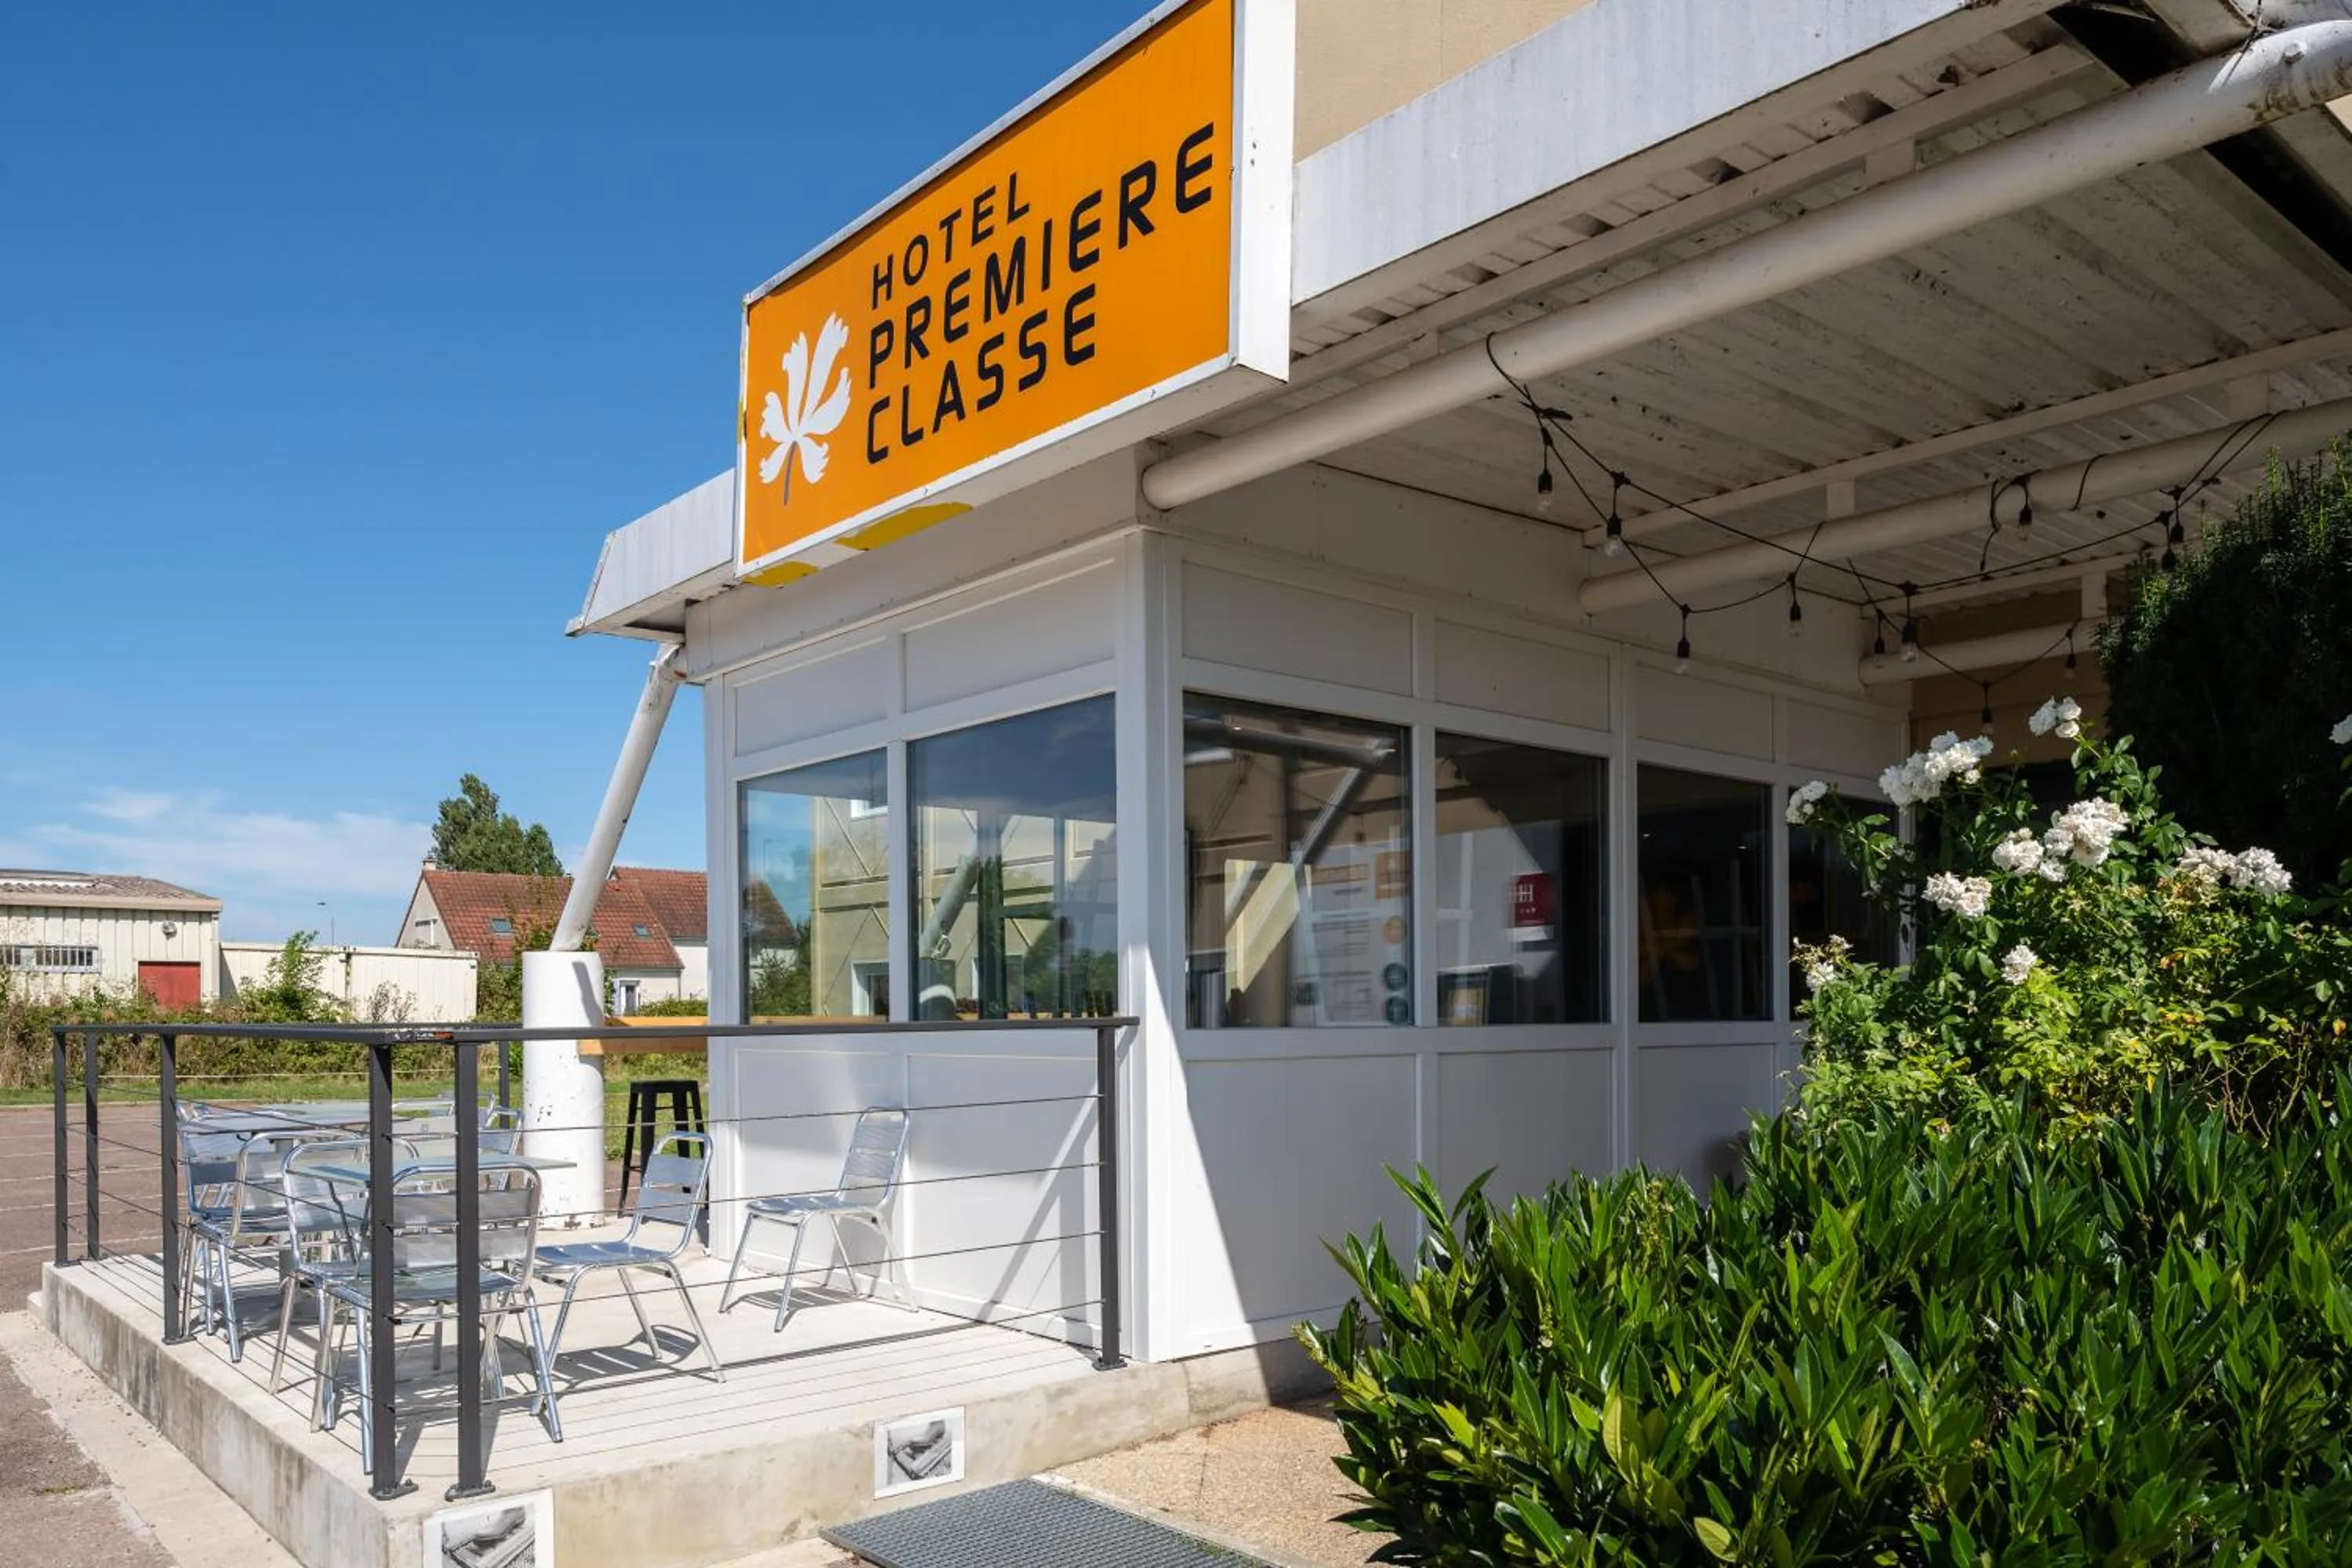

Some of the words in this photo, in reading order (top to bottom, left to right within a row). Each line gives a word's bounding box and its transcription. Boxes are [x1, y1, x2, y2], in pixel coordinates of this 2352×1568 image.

[868, 122, 1214, 390] PREMIERE
[870, 171, 1031, 311] HOTEL
[866, 282, 1097, 466] CLASSE
